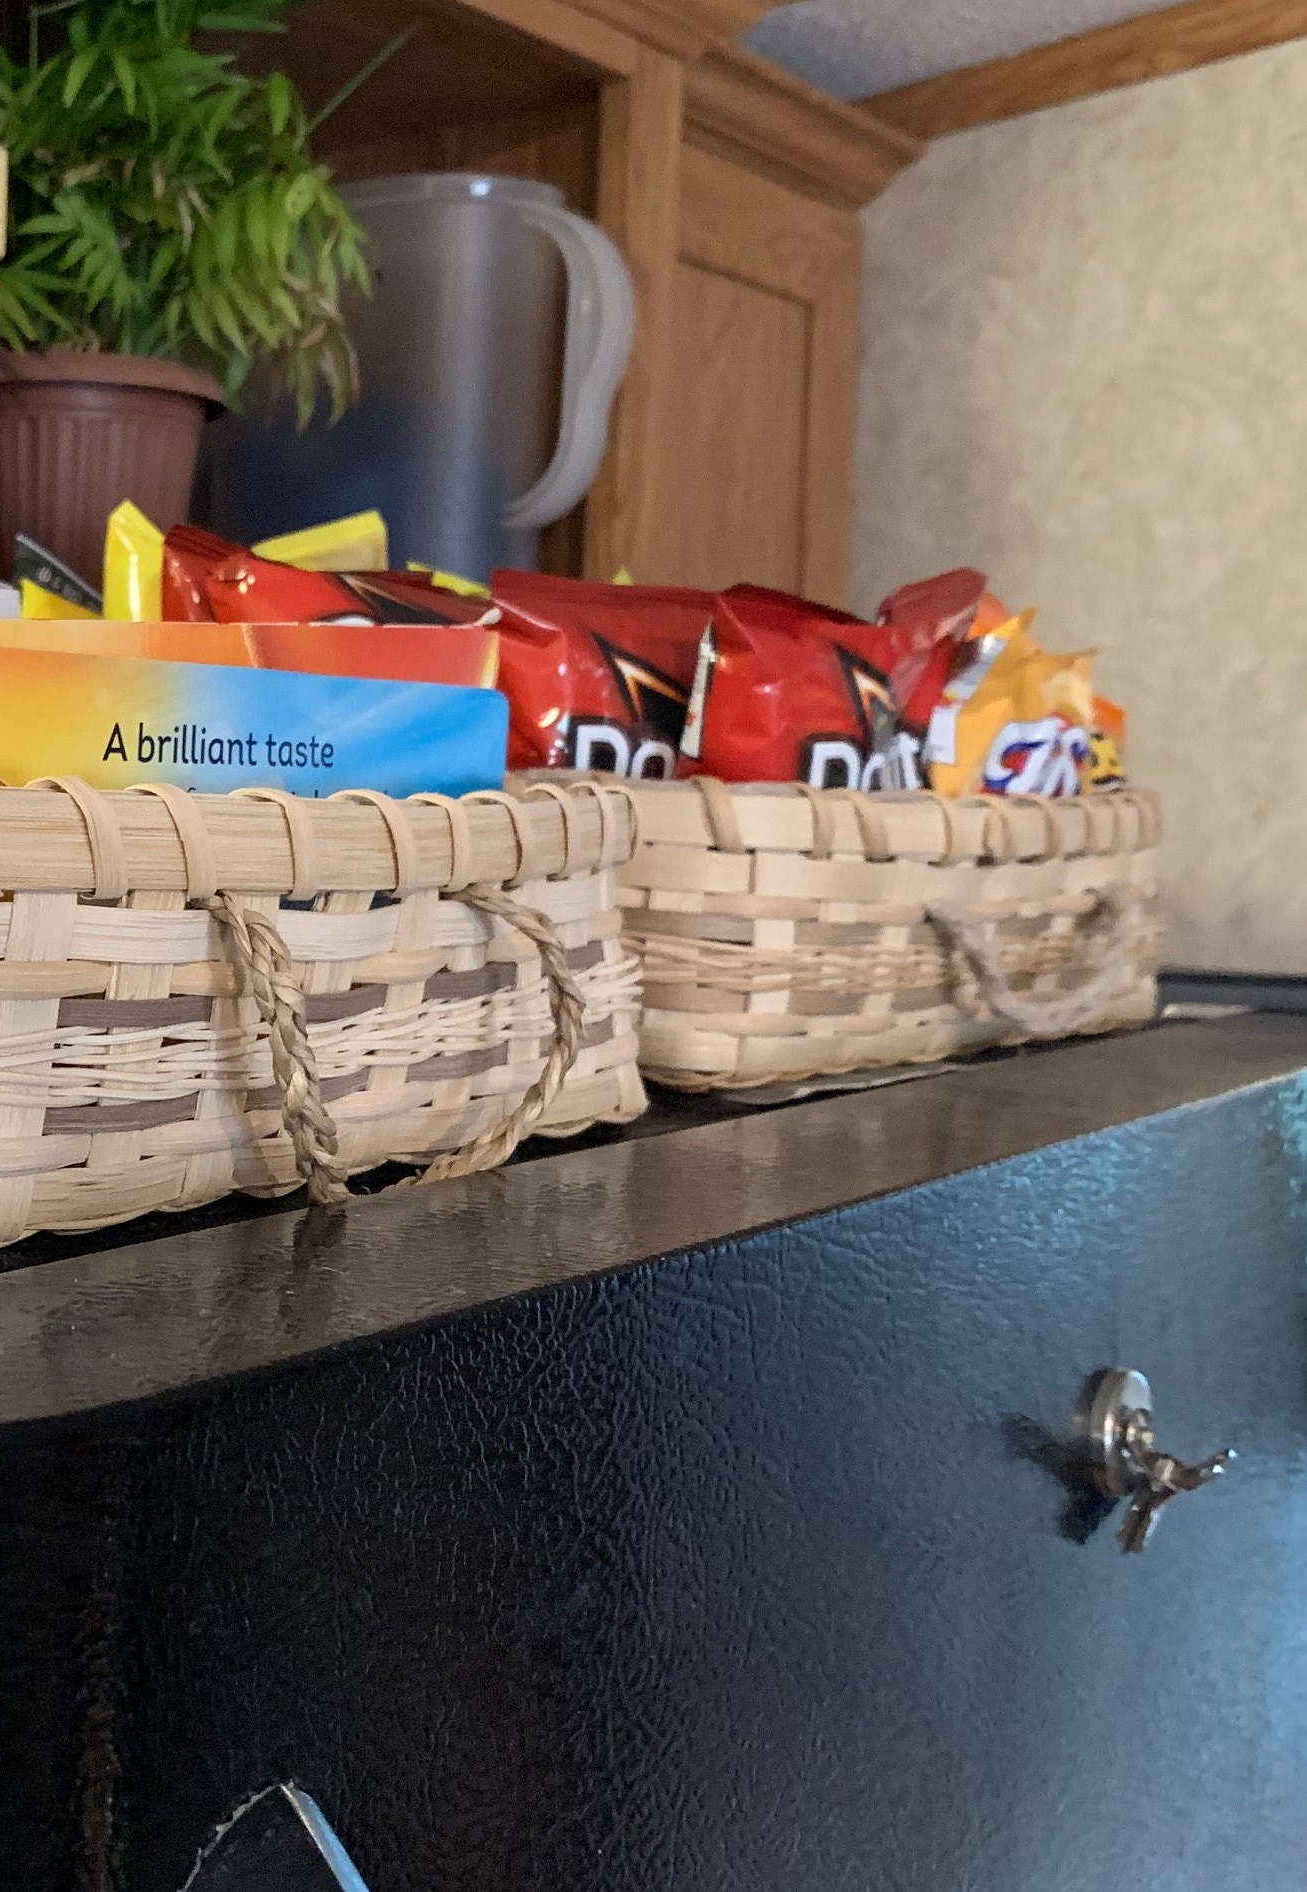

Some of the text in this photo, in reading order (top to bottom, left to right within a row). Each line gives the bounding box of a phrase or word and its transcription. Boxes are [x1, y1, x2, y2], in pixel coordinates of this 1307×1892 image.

[103, 722, 335, 768] A brilliant taste
